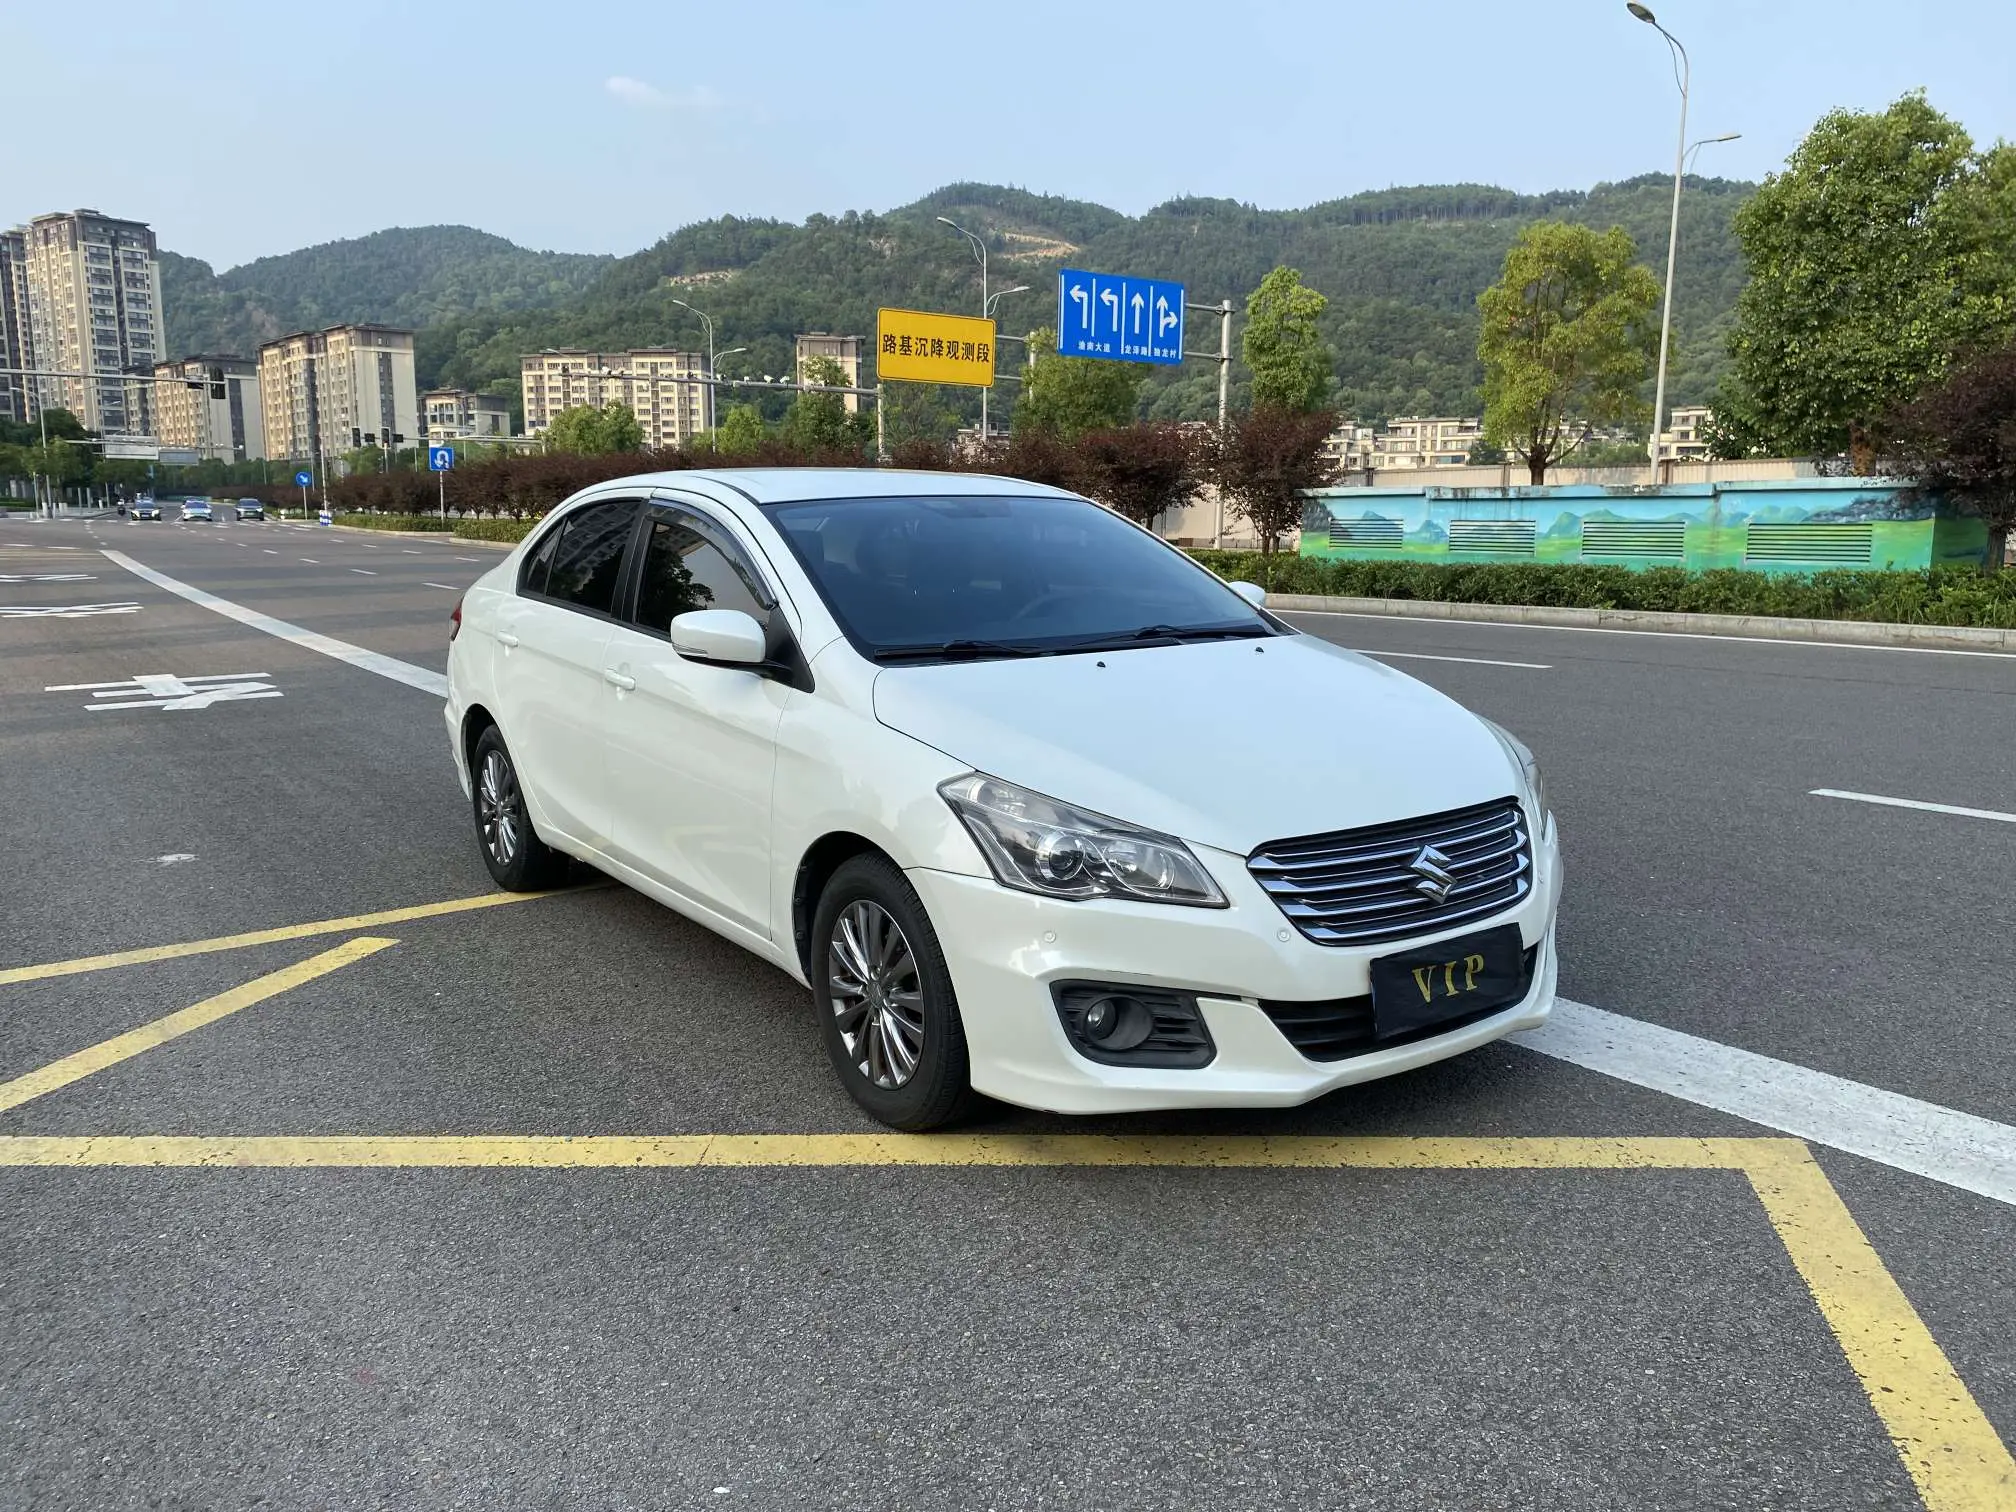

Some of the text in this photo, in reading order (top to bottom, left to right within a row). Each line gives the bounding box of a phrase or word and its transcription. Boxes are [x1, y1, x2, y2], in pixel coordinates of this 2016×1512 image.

[882, 333, 990, 363] 路基沉降观测段
[1078, 340, 1111, 353] 渝南大道
[1411, 954, 1484, 1003] VIP
